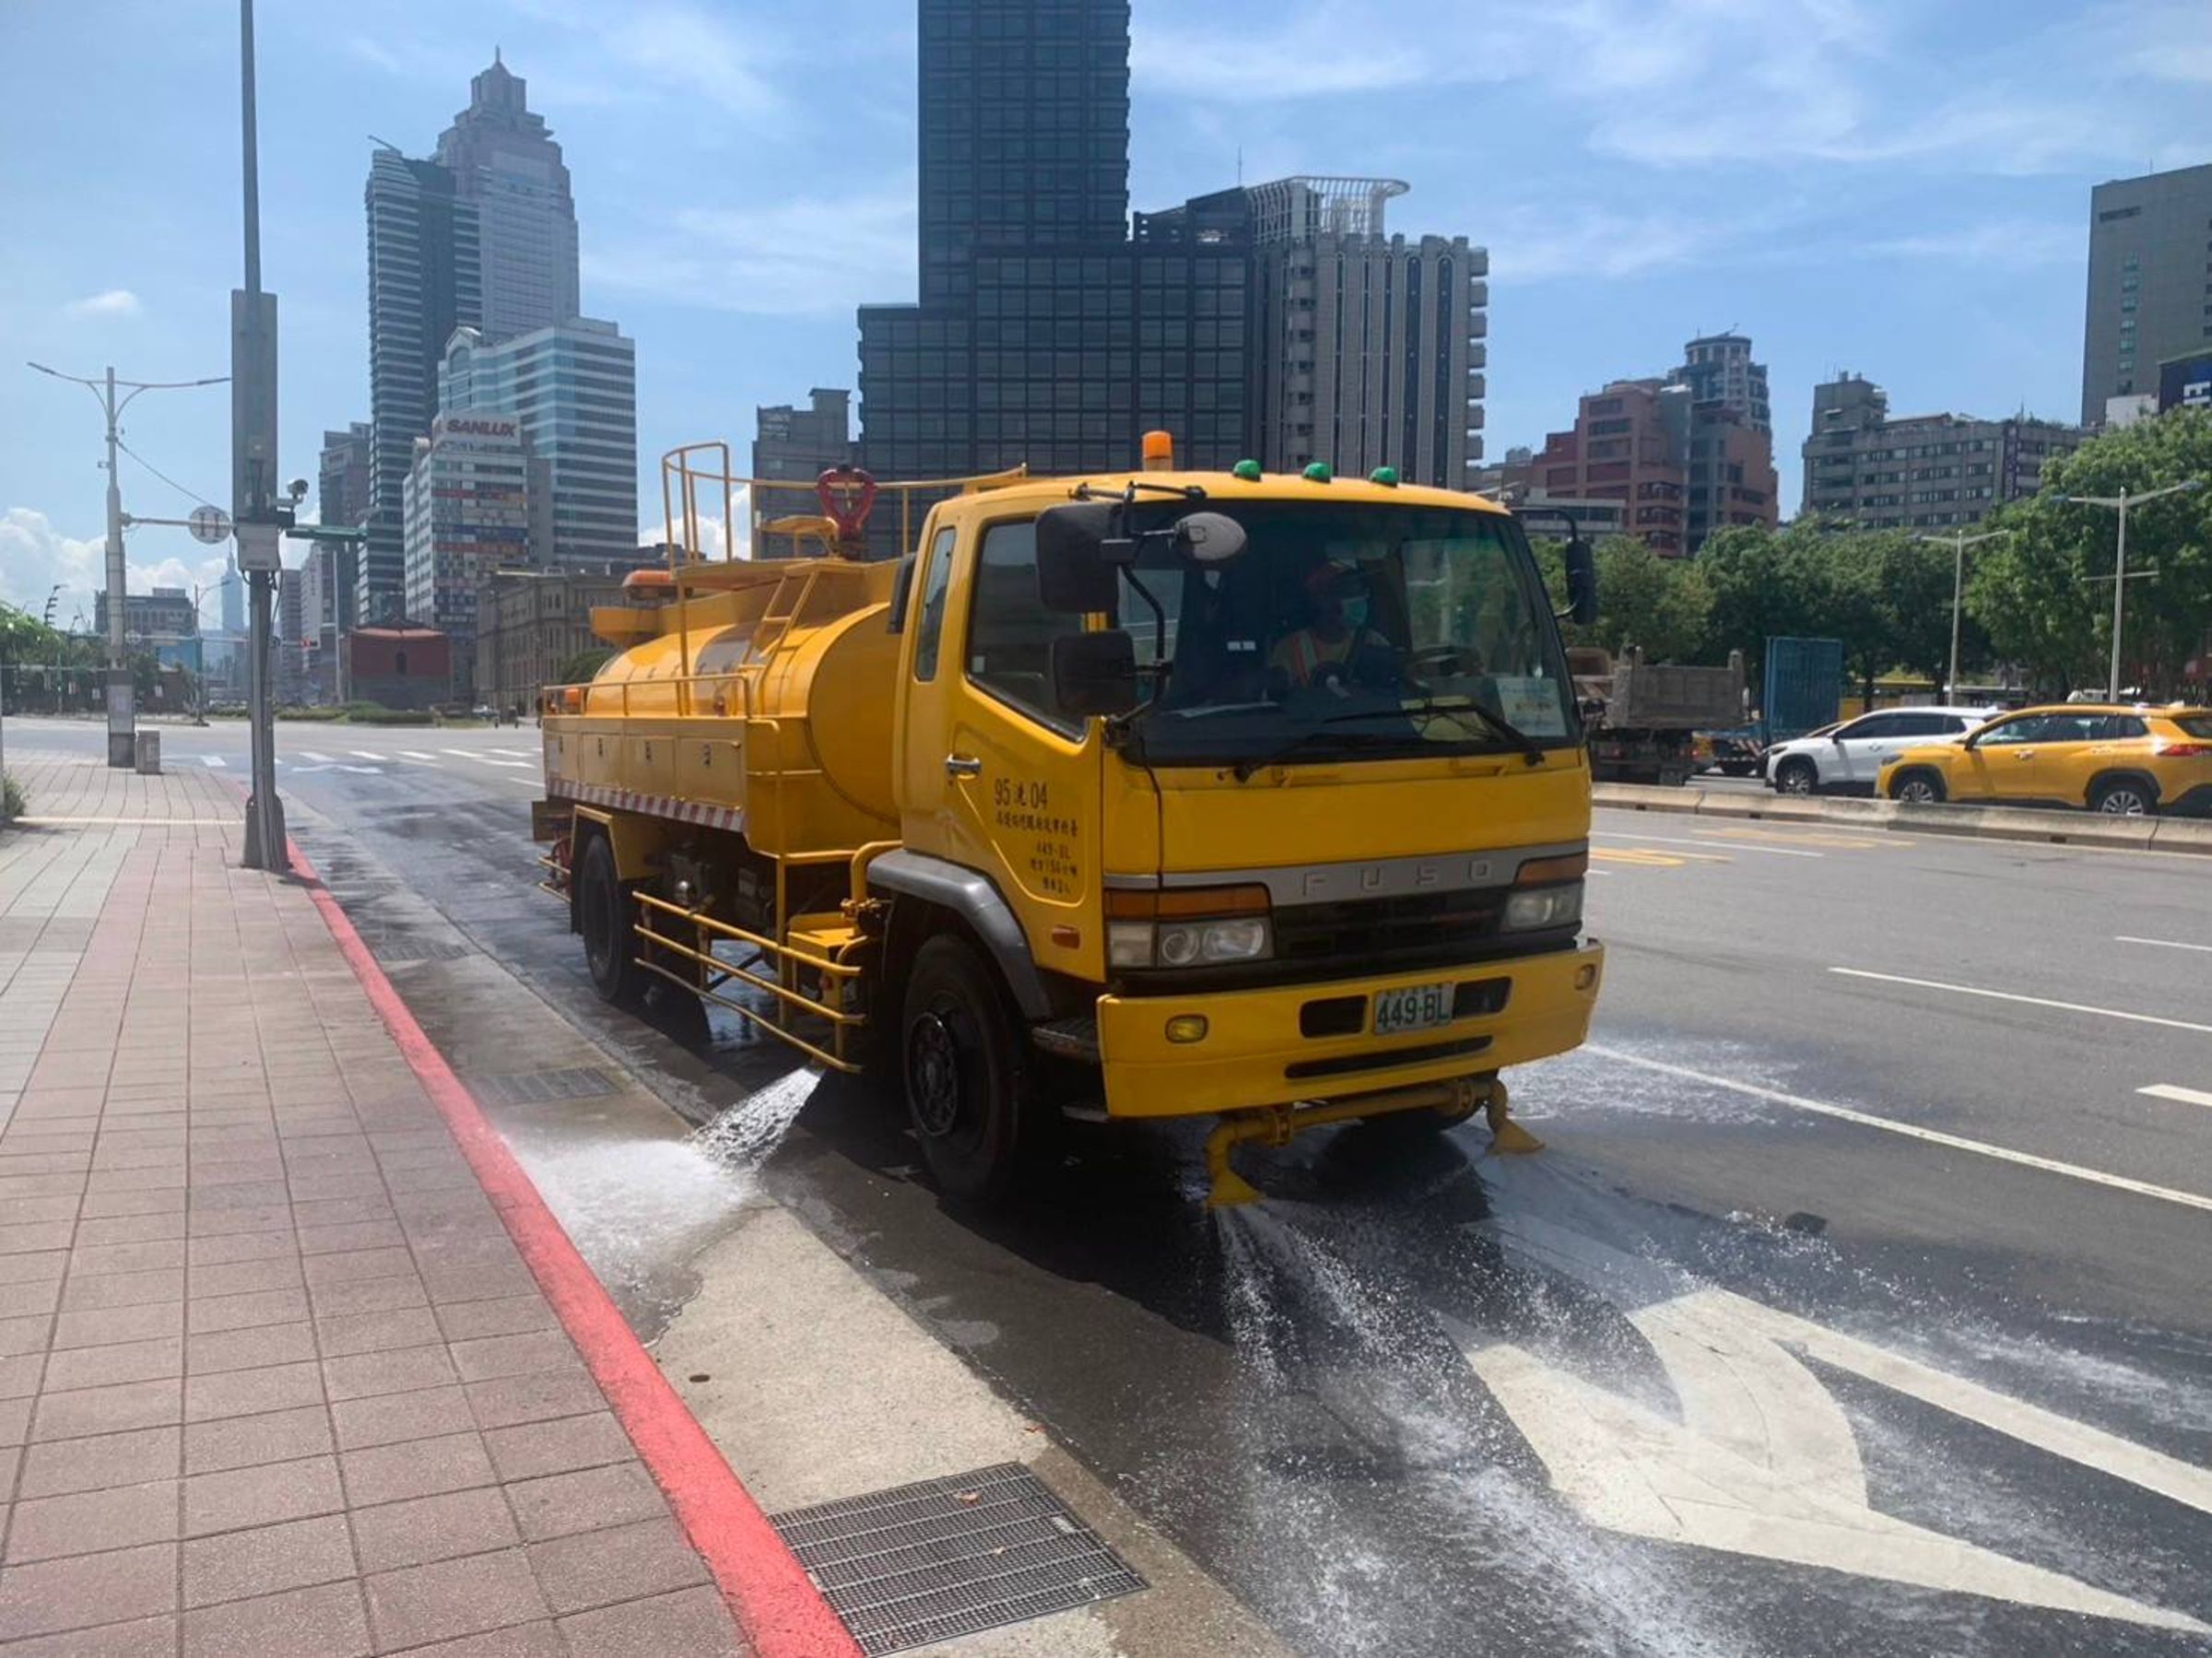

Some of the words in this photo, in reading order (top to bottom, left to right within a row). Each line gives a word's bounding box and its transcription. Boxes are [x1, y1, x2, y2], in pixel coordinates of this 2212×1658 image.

[447, 419, 515, 438] SANLUX
[1302, 860, 1490, 898] FUSO
[1377, 992, 1450, 1029] 449-BL
